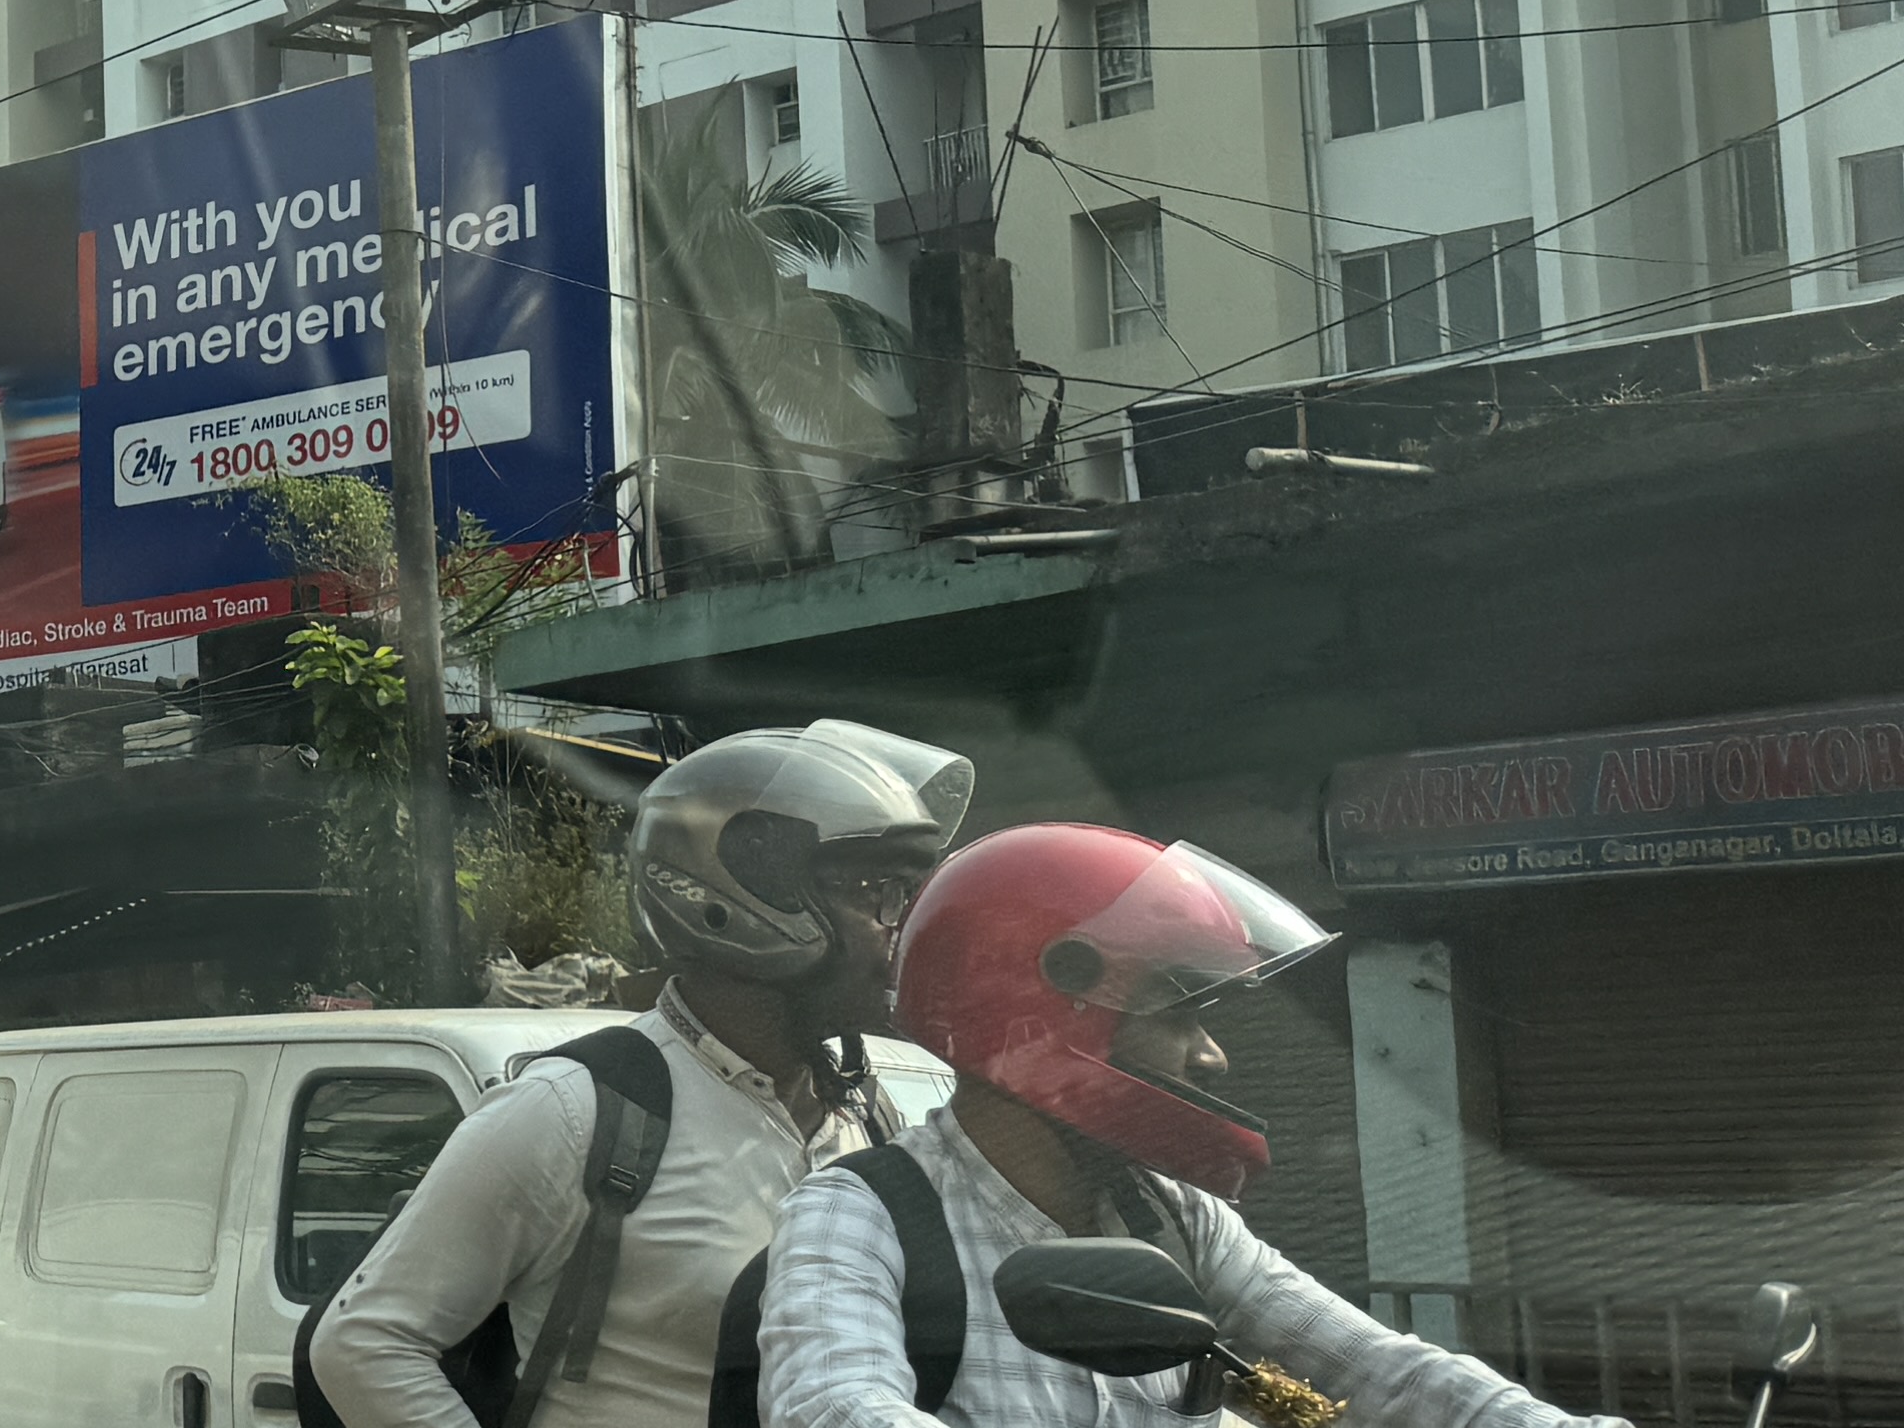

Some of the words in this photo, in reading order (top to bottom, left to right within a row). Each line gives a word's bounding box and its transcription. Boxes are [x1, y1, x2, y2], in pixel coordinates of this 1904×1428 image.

[112, 199, 238, 270] With
[255, 178, 362, 251] you
[112, 278, 158, 329] in
[176, 255, 278, 315] any
[250, 400, 351, 434] AMBULANCE
[355, 394, 388, 416] SER
[475, 378, 488, 391] 10
[133, 444, 176, 487] 24/7
[190, 439, 276, 484] 1800
[287, 424, 354, 466] 309
[366, 404, 460, 453] 09
[44, 619, 107, 644] Stroke
[113, 613, 127, 633] &
[132, 604, 207, 631] Trauma
[213, 594, 270, 620] Team
[1341, 755, 1577, 835] SARKAR
[1517, 843, 1591, 871] Road,
[1601, 833, 1783, 869] Ganganagar,
[1791, 821, 1904, 854] Doltala,
